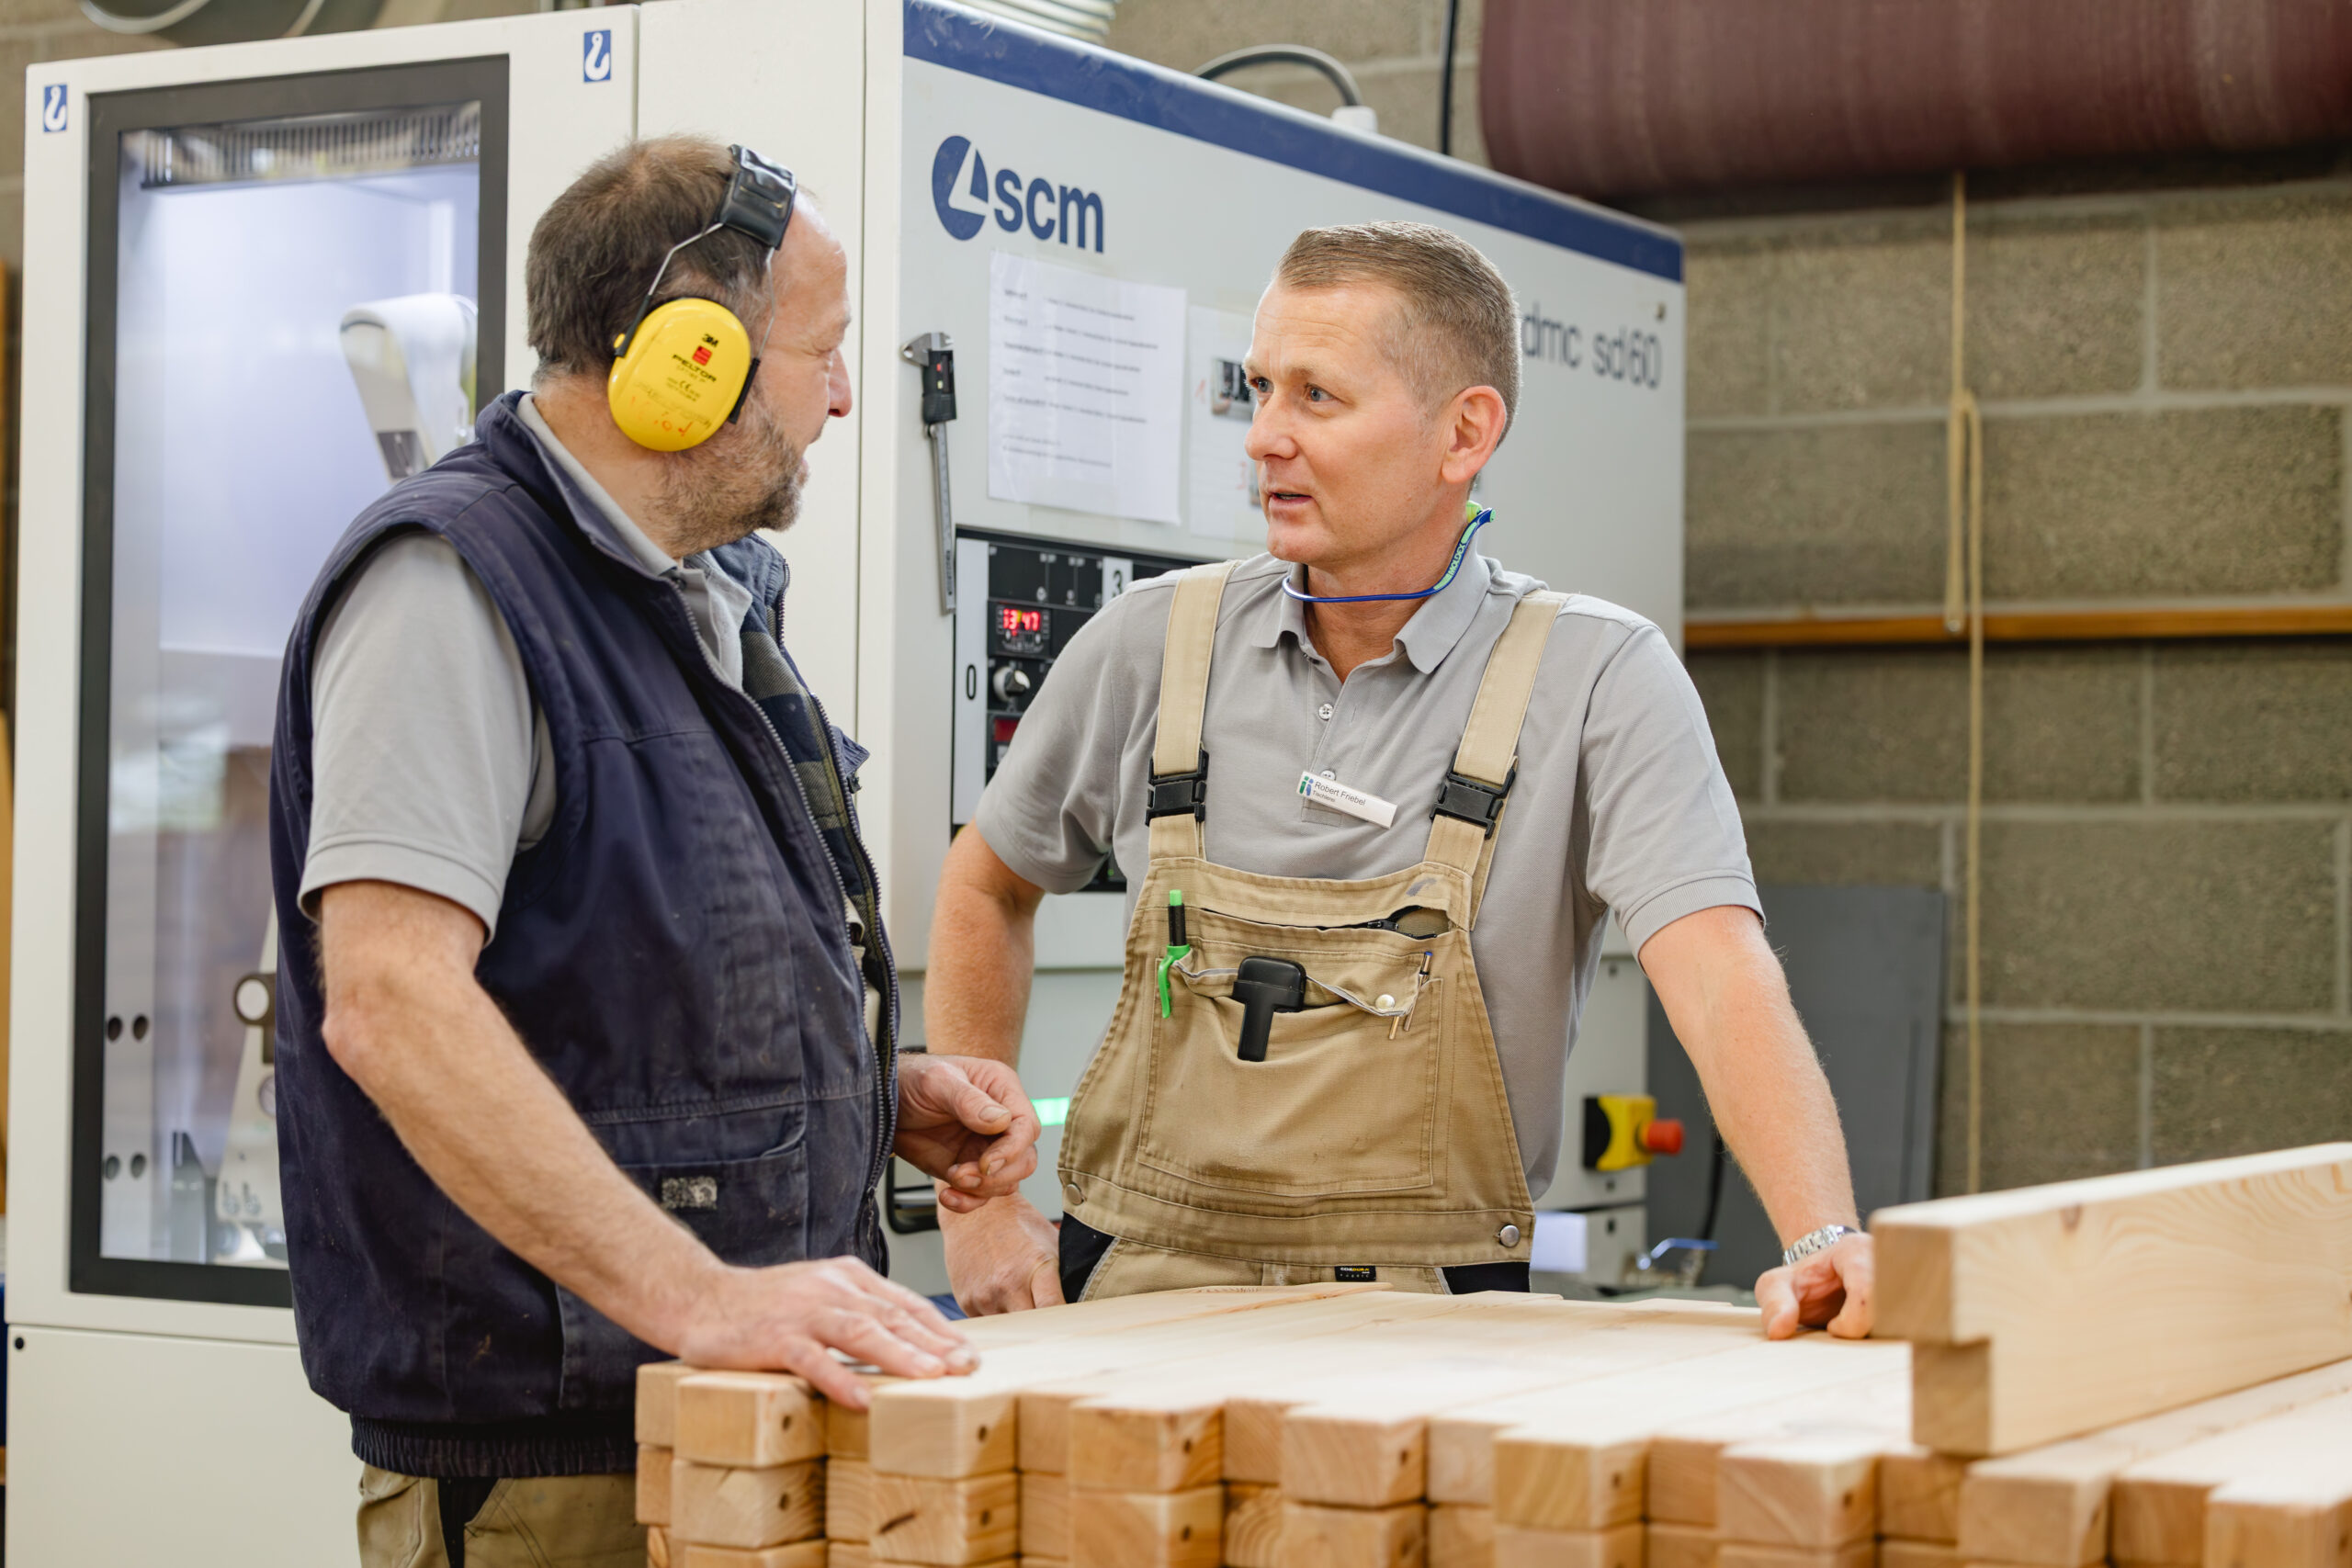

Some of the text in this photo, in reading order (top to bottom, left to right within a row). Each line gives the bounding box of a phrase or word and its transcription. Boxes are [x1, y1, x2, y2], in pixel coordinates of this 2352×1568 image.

[994, 169, 1104, 254] scm
[702, 333, 718, 347] 3M
[1521, 302, 1582, 369] dmc
[673, 354, 717, 383] PELTOR
[1447, 542, 1466, 577] MOLDEX
[1112, 569, 1124, 598] 3
[1314, 781, 1367, 806] Robert Friebel
